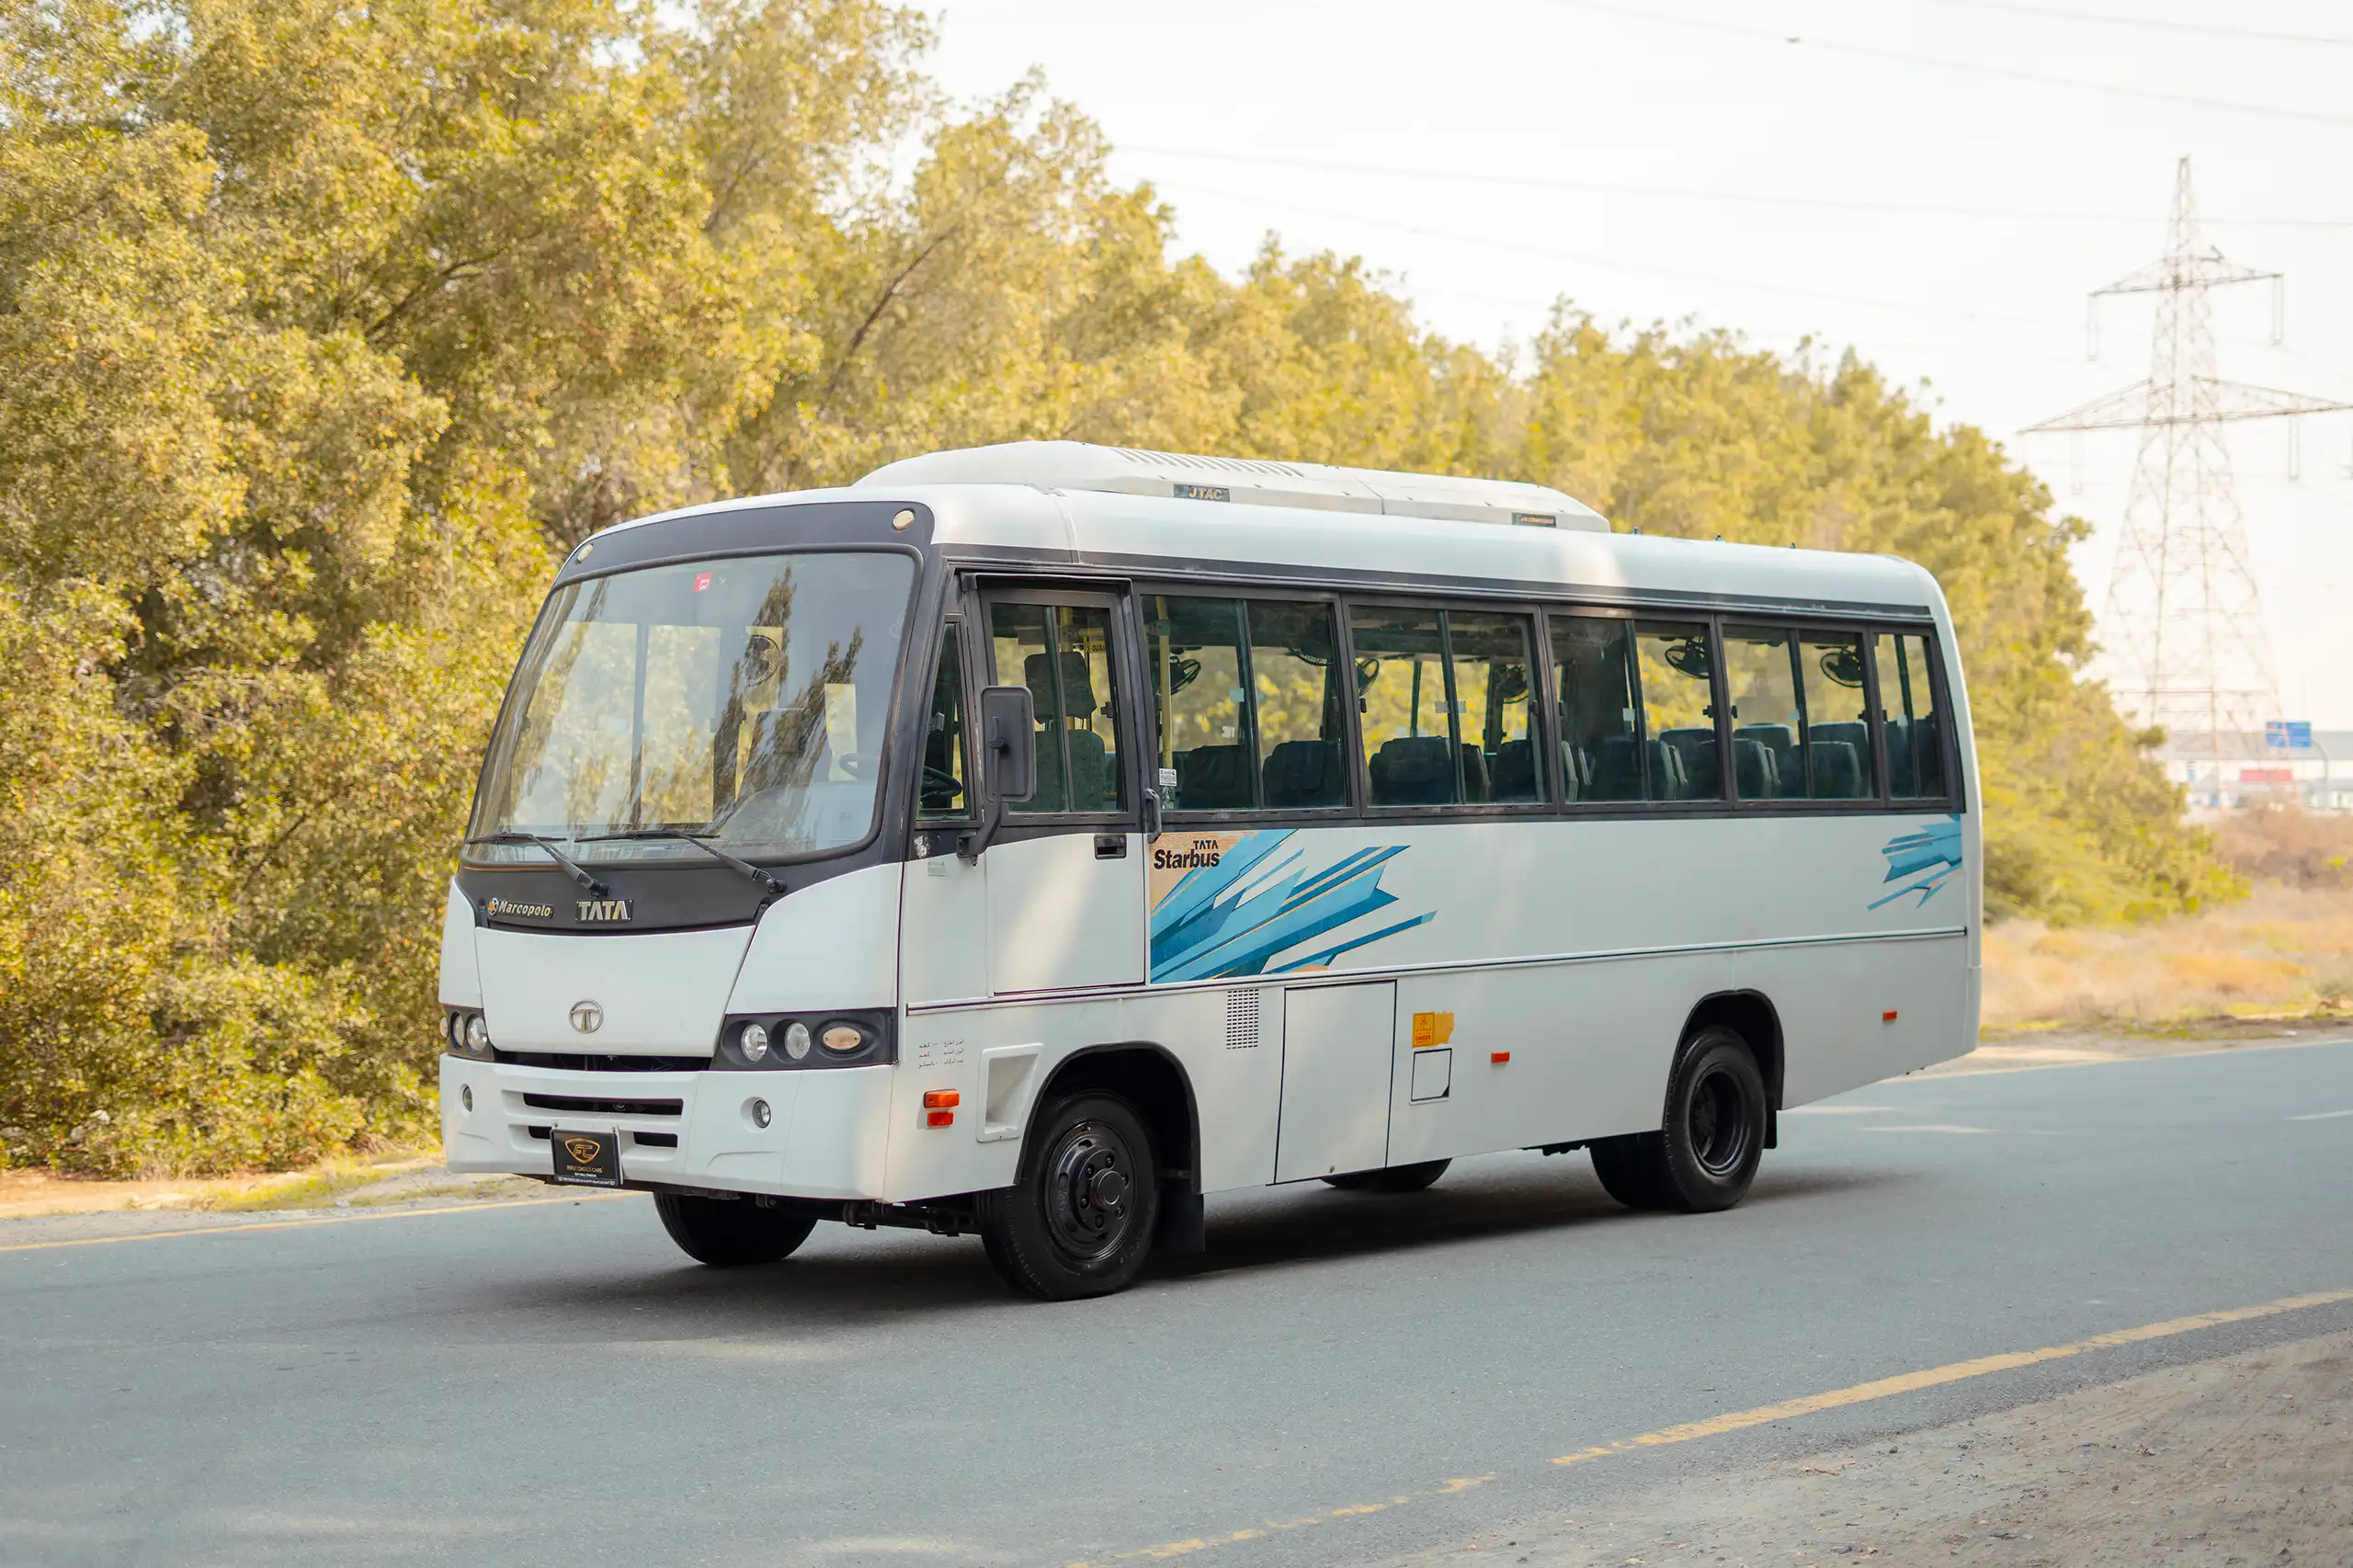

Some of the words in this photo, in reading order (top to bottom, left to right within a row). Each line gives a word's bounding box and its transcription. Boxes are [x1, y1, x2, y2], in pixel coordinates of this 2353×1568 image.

[1188, 487, 1222, 500] JTAC
[1193, 839, 1219, 850] TATA
[1154, 848, 1221, 869] Starbus
[498, 900, 552, 917] Marcopolo
[578, 900, 629, 921] TATA
